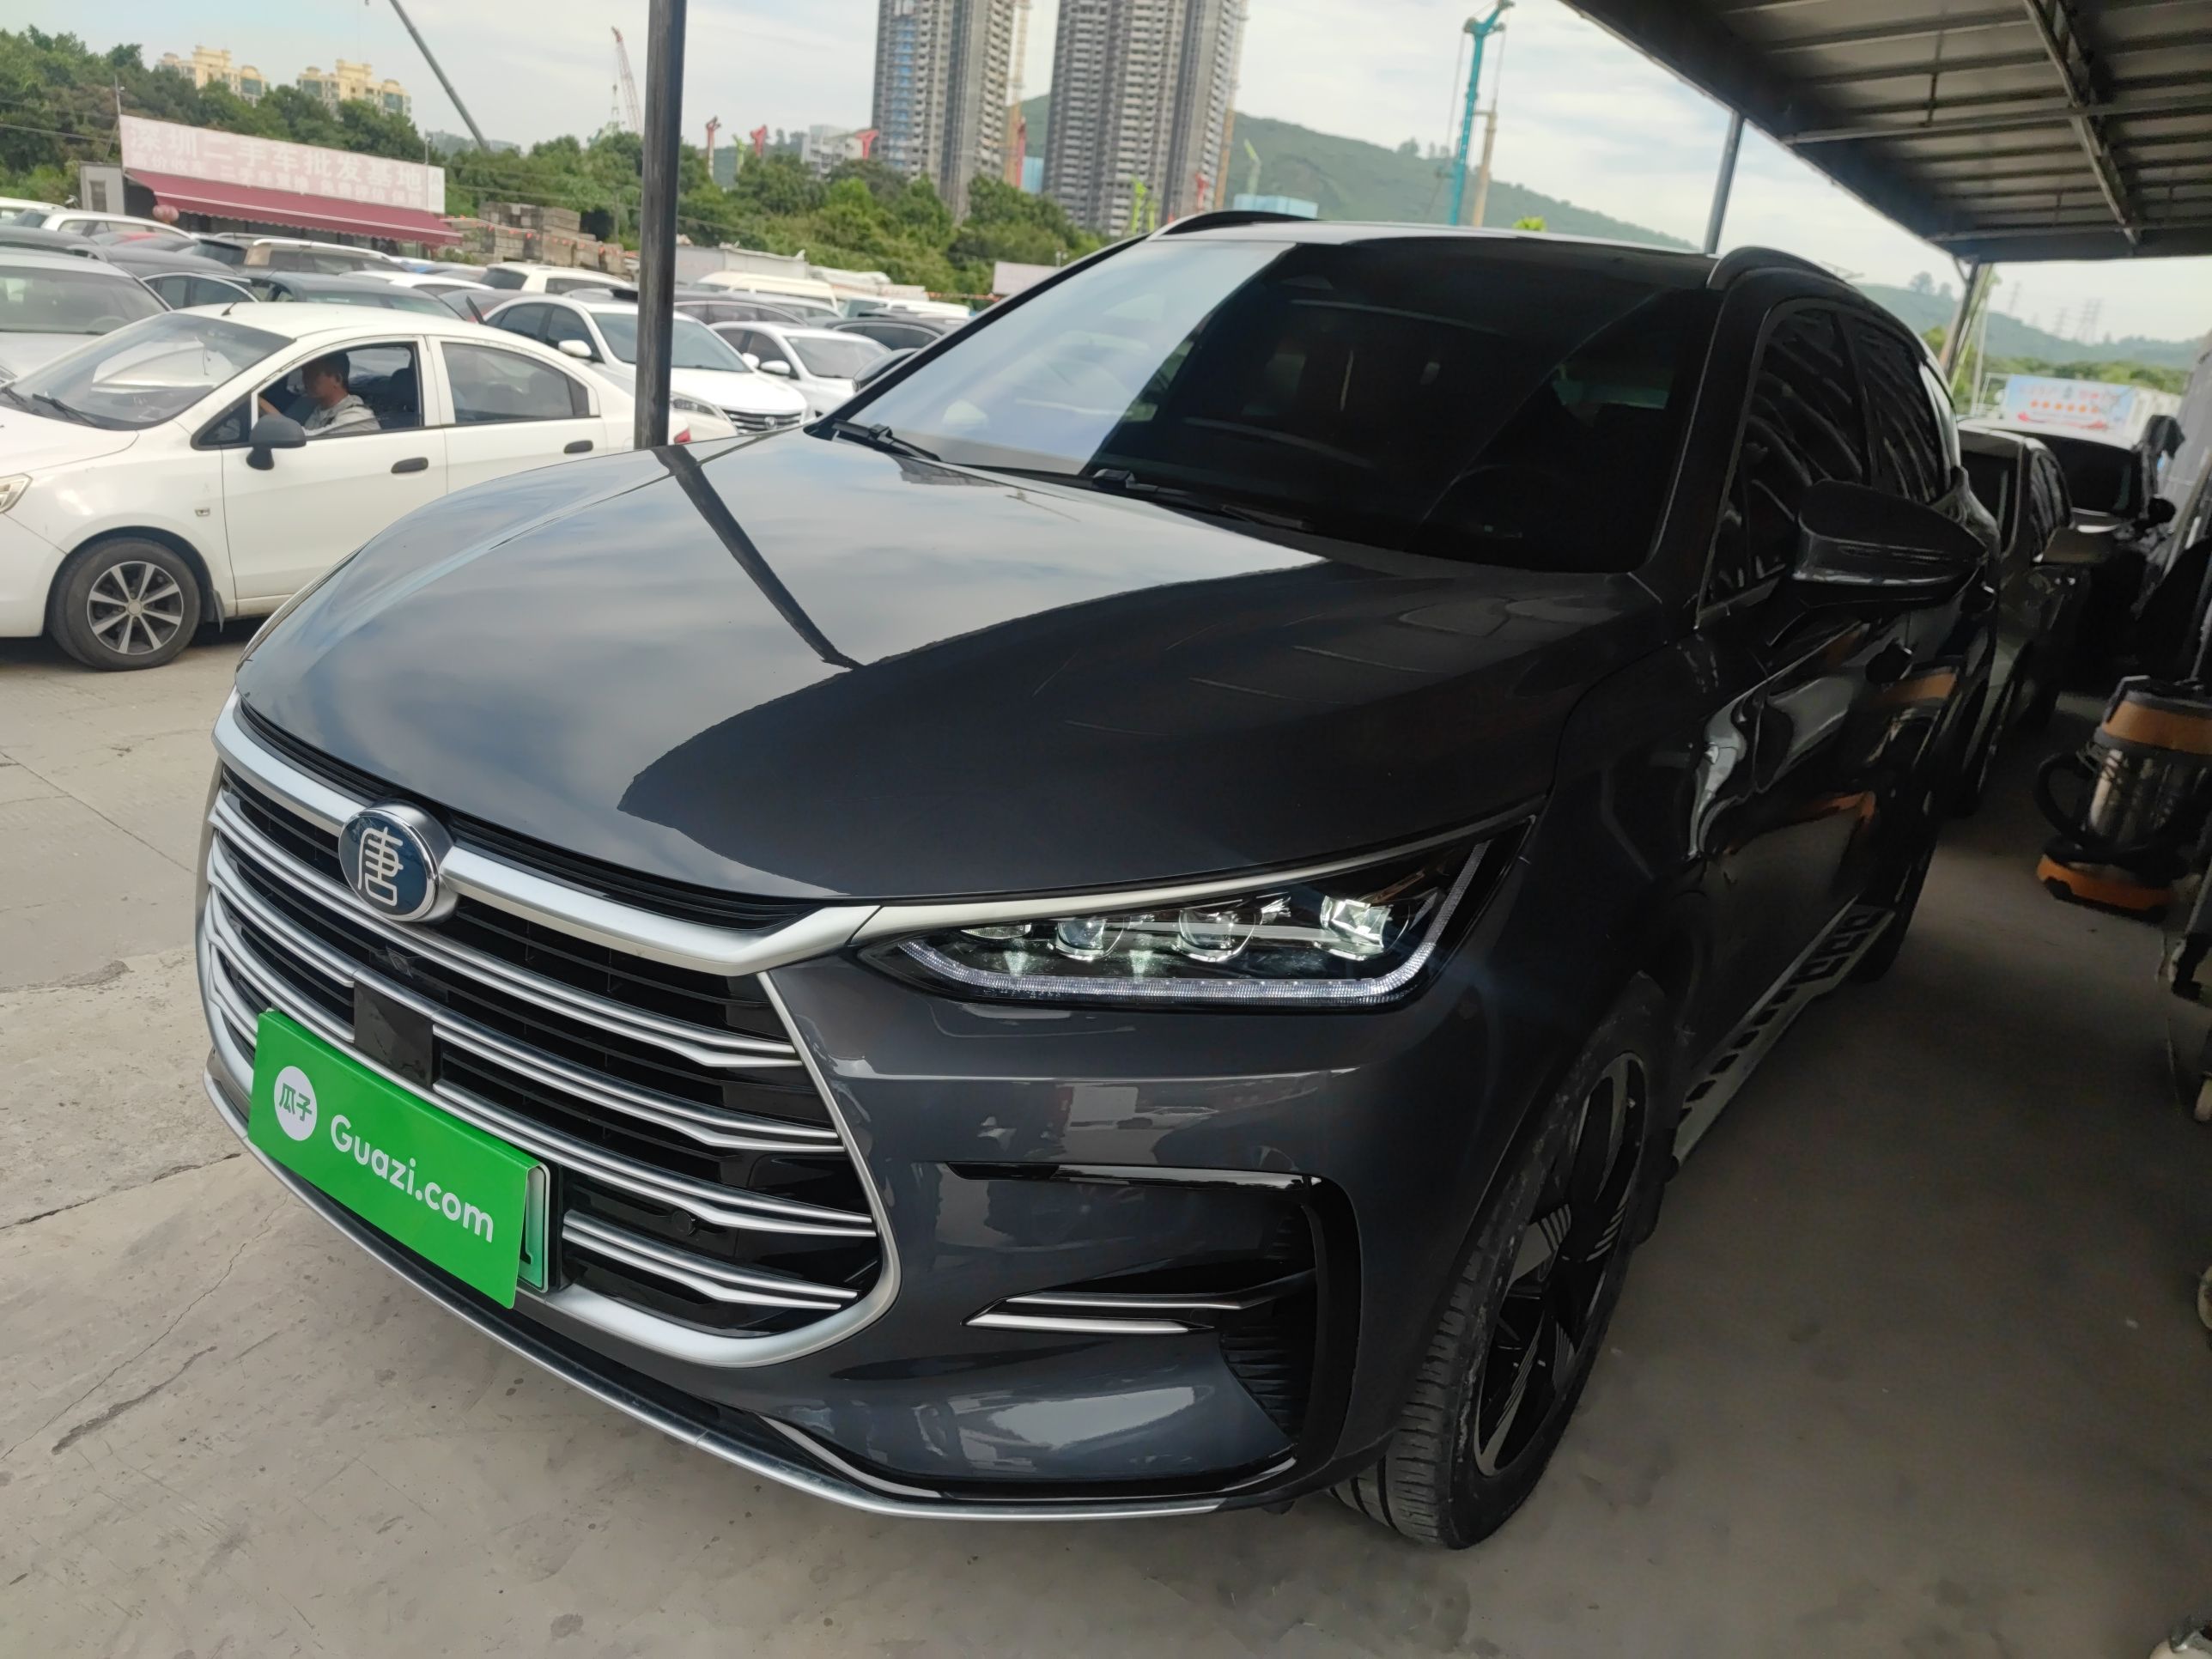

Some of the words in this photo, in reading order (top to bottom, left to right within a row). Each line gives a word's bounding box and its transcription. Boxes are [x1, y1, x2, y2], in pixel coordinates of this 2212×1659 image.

[131, 126, 422, 191] 深圳二手车批发基地
[357, 826, 404, 907] 唐
[278, 1082, 313, 1122] 瓜子
[331, 1114, 494, 1243] Guazi.com
